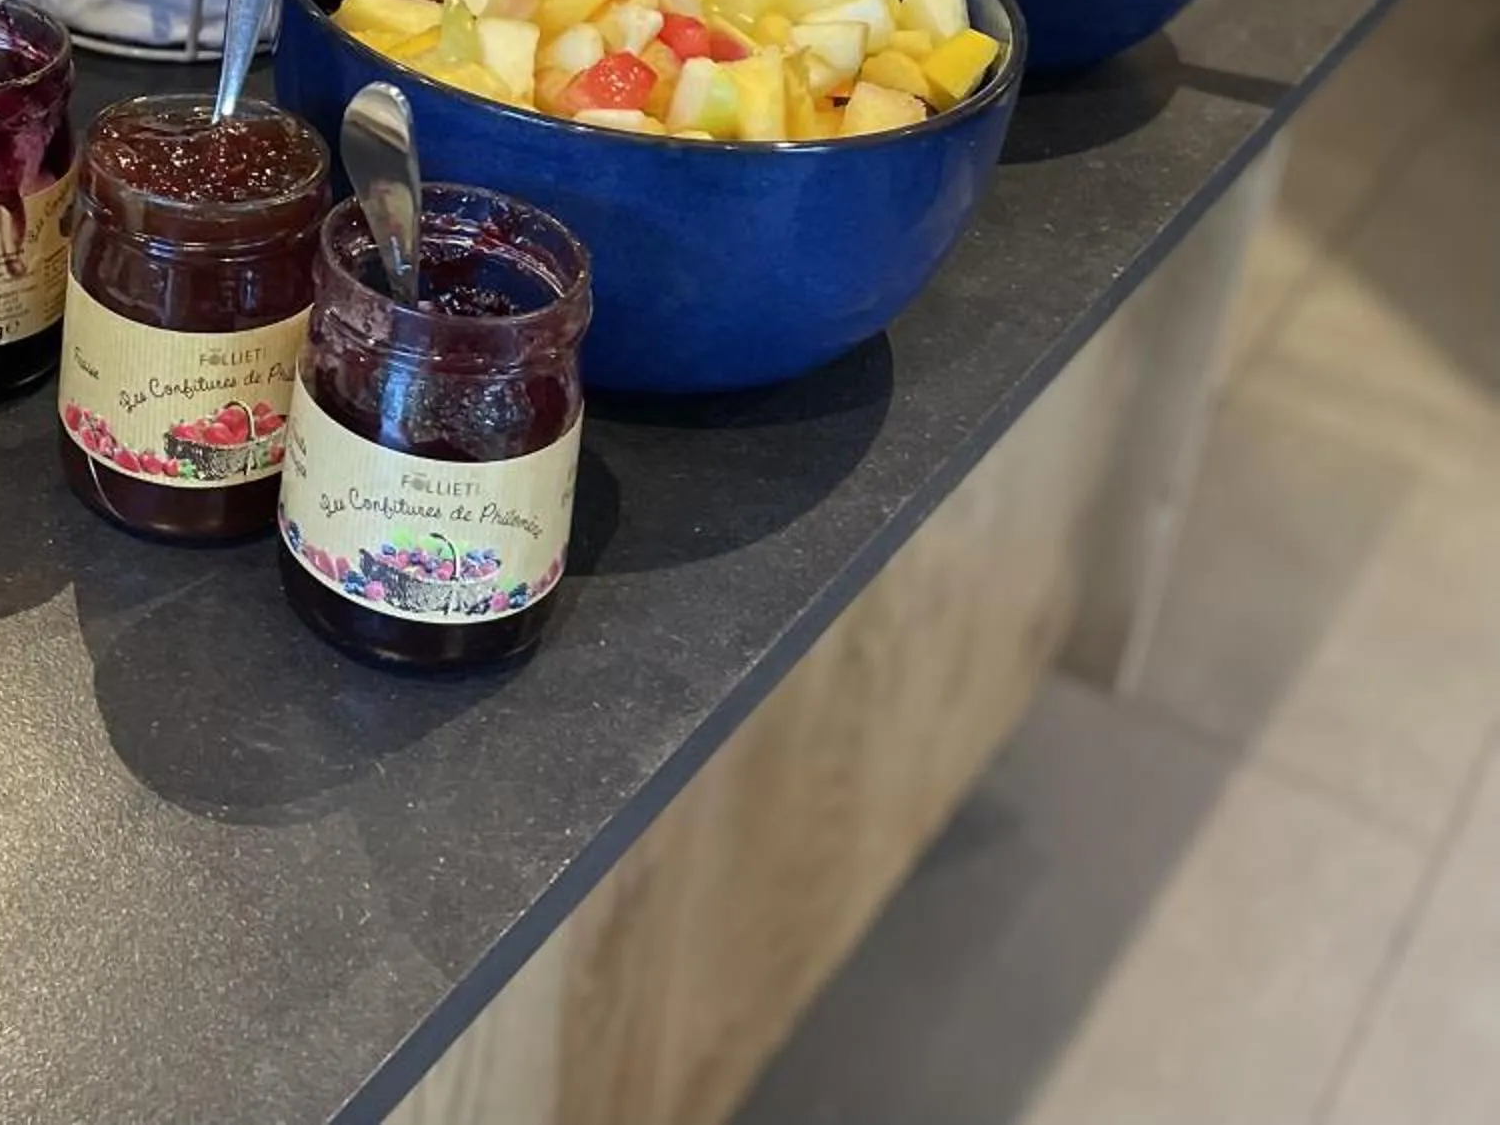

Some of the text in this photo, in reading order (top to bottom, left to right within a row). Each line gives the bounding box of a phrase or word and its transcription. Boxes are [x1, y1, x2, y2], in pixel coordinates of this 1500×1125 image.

[148, 372, 238, 399] Confitures
[243, 370, 261, 386] de
[349, 486, 443, 520] Confitures
[450, 504, 473, 522] de
